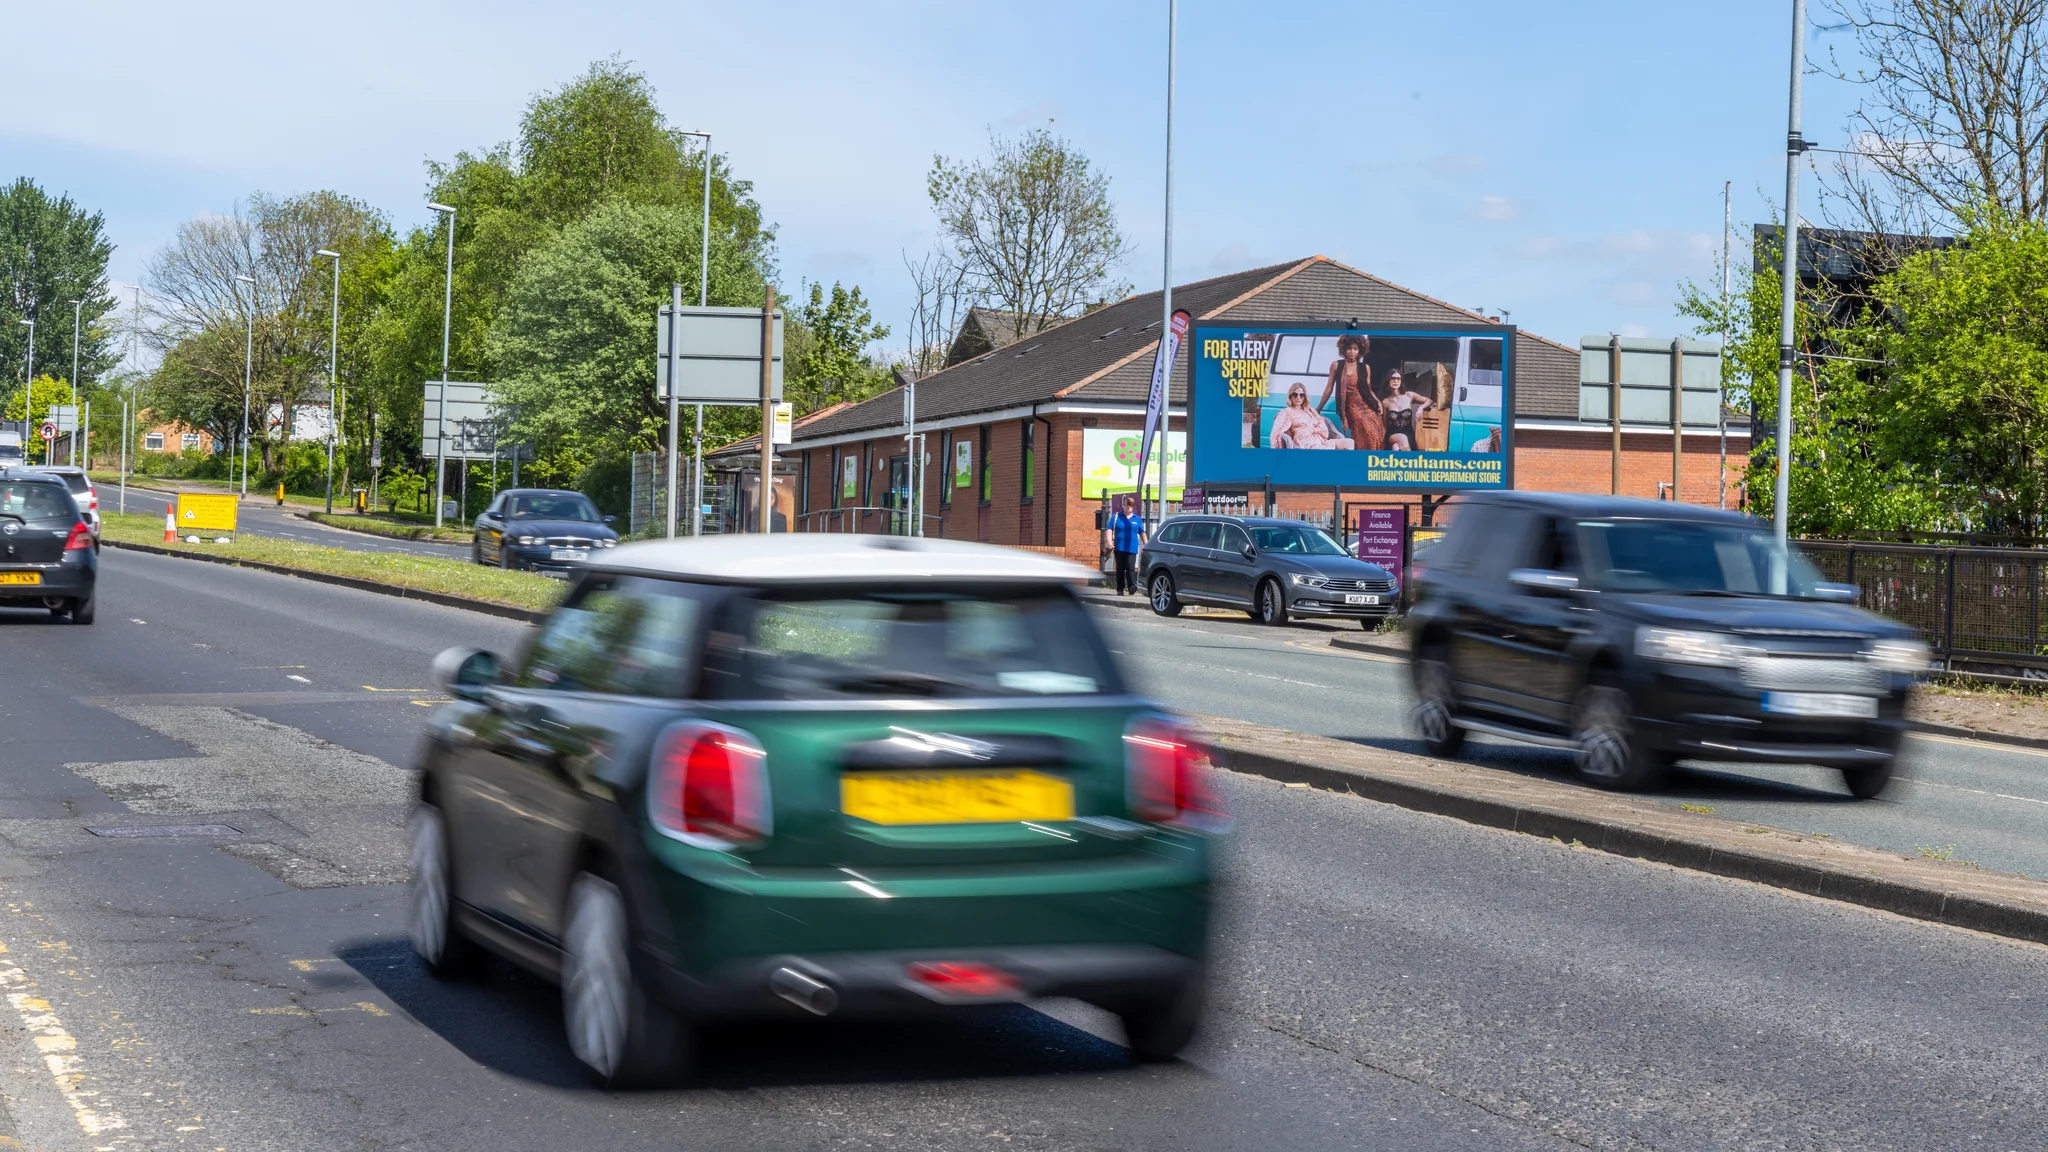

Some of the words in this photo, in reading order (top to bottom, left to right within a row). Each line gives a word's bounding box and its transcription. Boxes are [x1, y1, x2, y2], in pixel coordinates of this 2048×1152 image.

[1203, 339, 1229, 358] FOR
[1231, 340, 1271, 359] EVERY
[1221, 359, 1269, 378] SPRING
[1229, 378, 1269, 397] SCENE
[1367, 454, 1502, 470] Debenhams.com
[1147, 464, 1174, 475] tre
[1367, 470, 1404, 481] BRITAIN'S
[1404, 471, 1430, 482] ONLINE
[1431, 471, 1478, 483] DEPARTMENT
[1478, 472, 1501, 483] STORE
[1207, 495, 1238, 503] outdoor
[1371, 511, 1391, 519] Finance
[1369, 521, 1393, 529] Available
[1363, 536, 1373, 544] Part
[1373, 536, 1398, 545] Exchange
